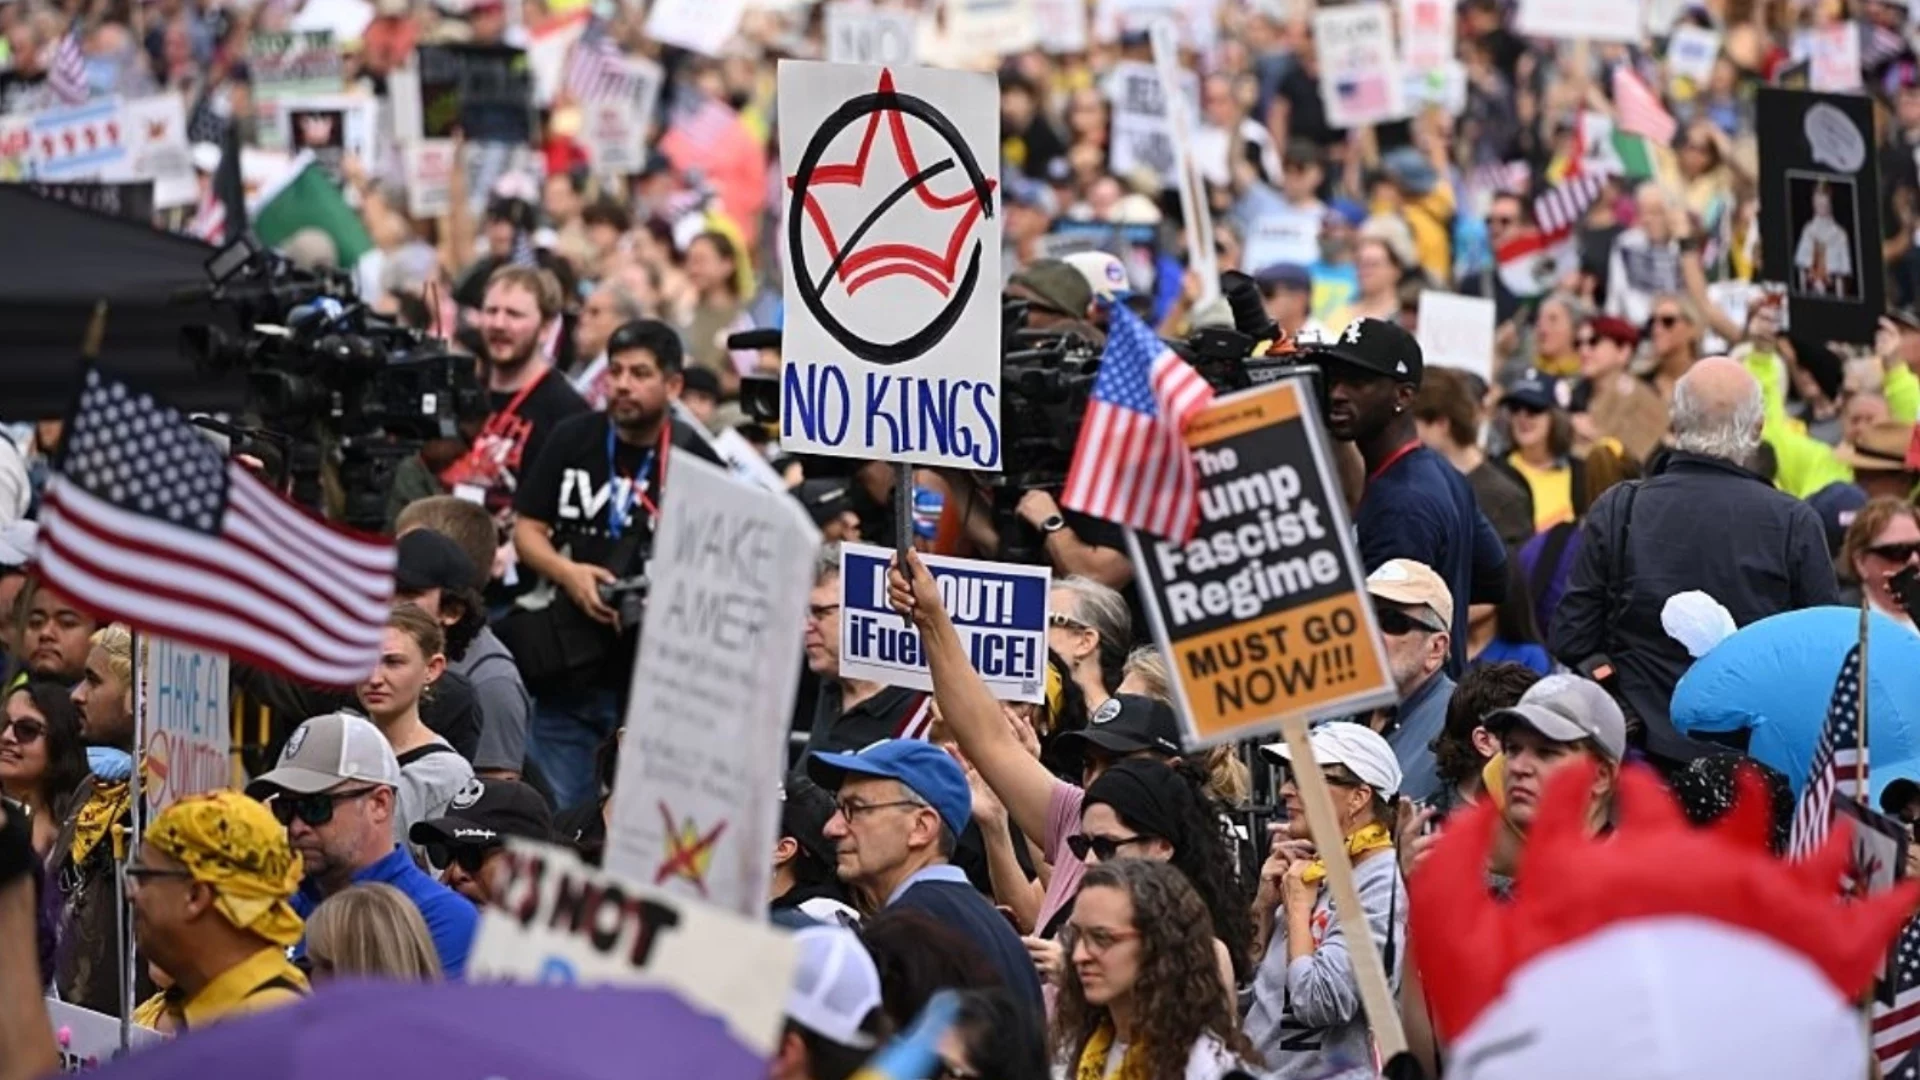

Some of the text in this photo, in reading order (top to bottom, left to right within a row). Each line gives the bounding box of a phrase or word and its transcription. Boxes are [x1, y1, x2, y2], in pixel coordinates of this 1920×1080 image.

[784, 362, 999, 467] NO KINGS
[1199, 464, 1301, 522] ump
[670, 502, 776, 592] WAKE
[1154, 498, 1326, 582] Fascist
[937, 573, 1015, 625] OUT!
[1165, 550, 1341, 626] Regime
[971, 631, 1036, 679] ICE!
[1185, 606, 1358, 680] MUST GO
[1213, 643, 1358, 717] NOW!!!
[158, 637, 220, 740] HAVE A
[549, 870, 681, 968] NOT
